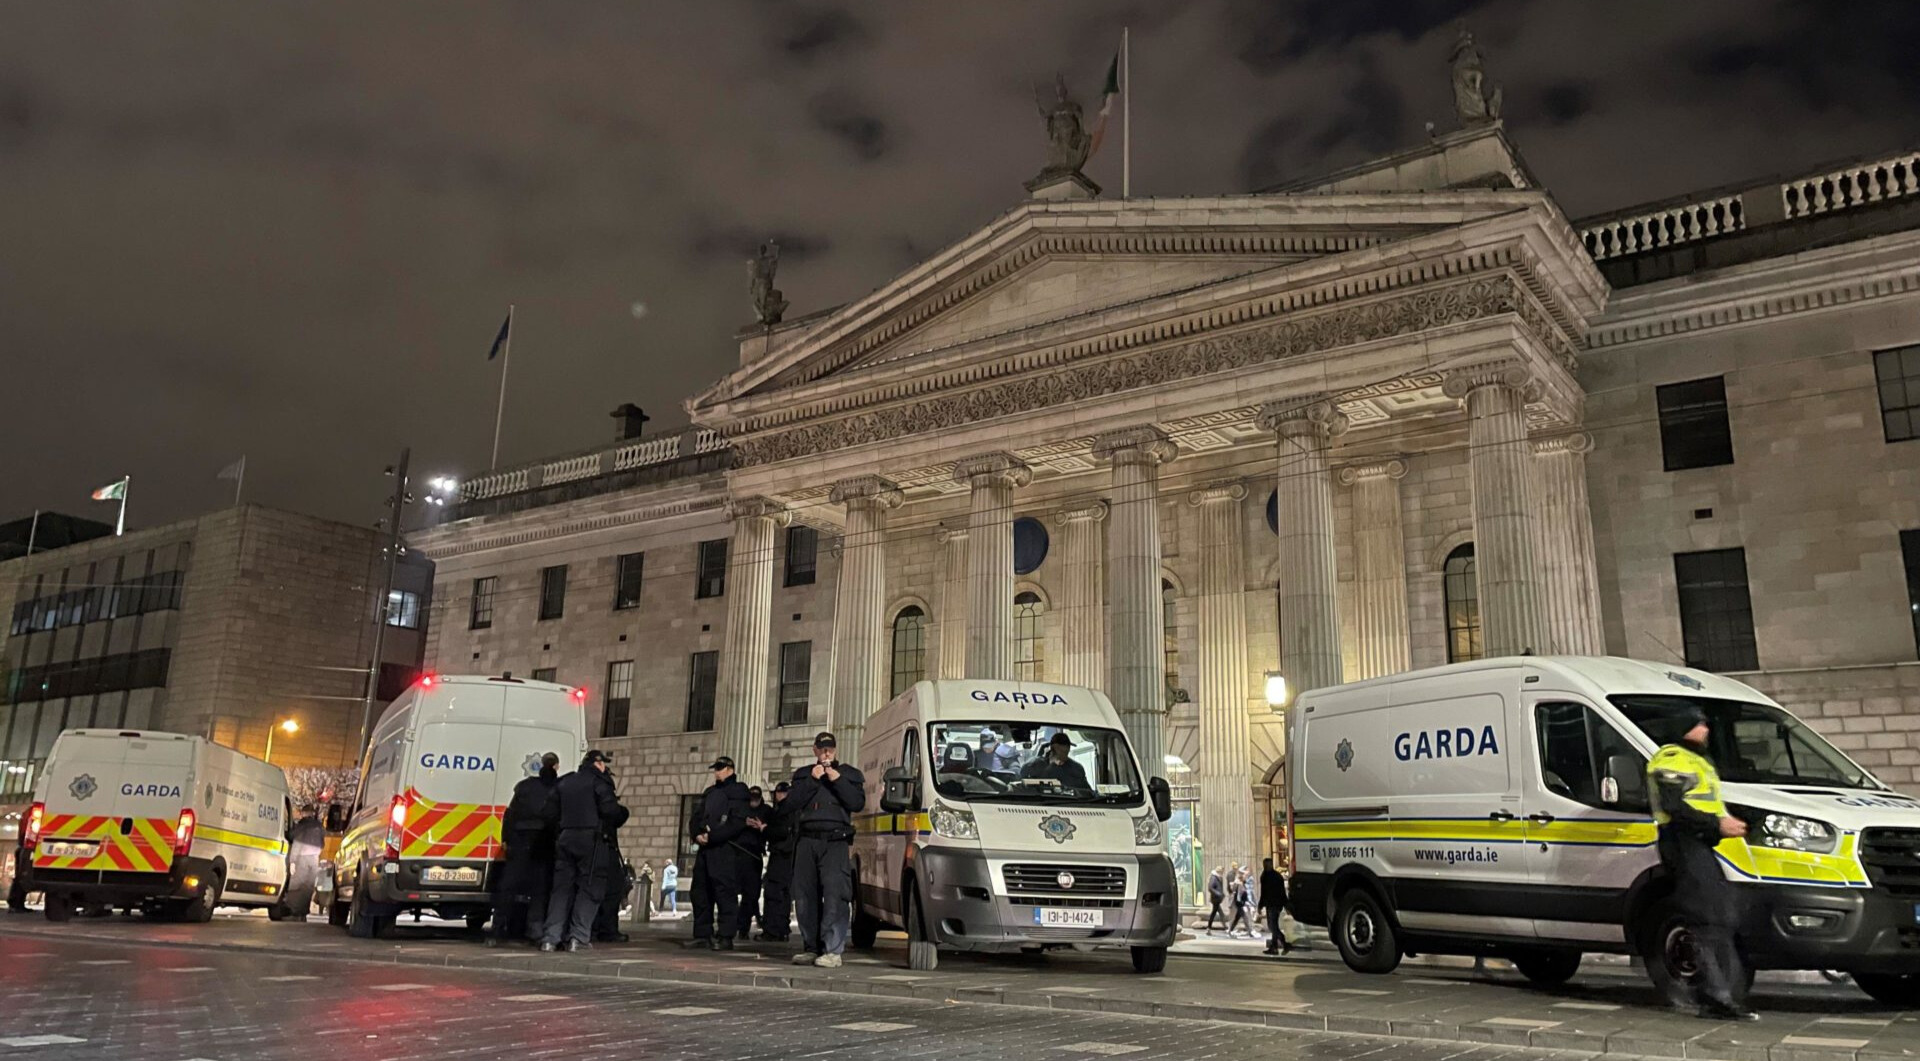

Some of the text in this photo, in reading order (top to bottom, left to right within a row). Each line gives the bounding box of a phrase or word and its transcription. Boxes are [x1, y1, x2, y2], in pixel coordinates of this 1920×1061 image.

[970, 690, 1068, 706] GARDA
[1394, 725, 1499, 761] GARDA
[420, 753, 495, 771] GARDA
[121, 783, 180, 797] GARDA
[258, 803, 278, 822] GARDA
[1322, 847, 1374, 858] 1 800 666 111
[1414, 847, 1498, 864] www.garda.ie
[1048, 911, 1094, 923] 131-D-14124
